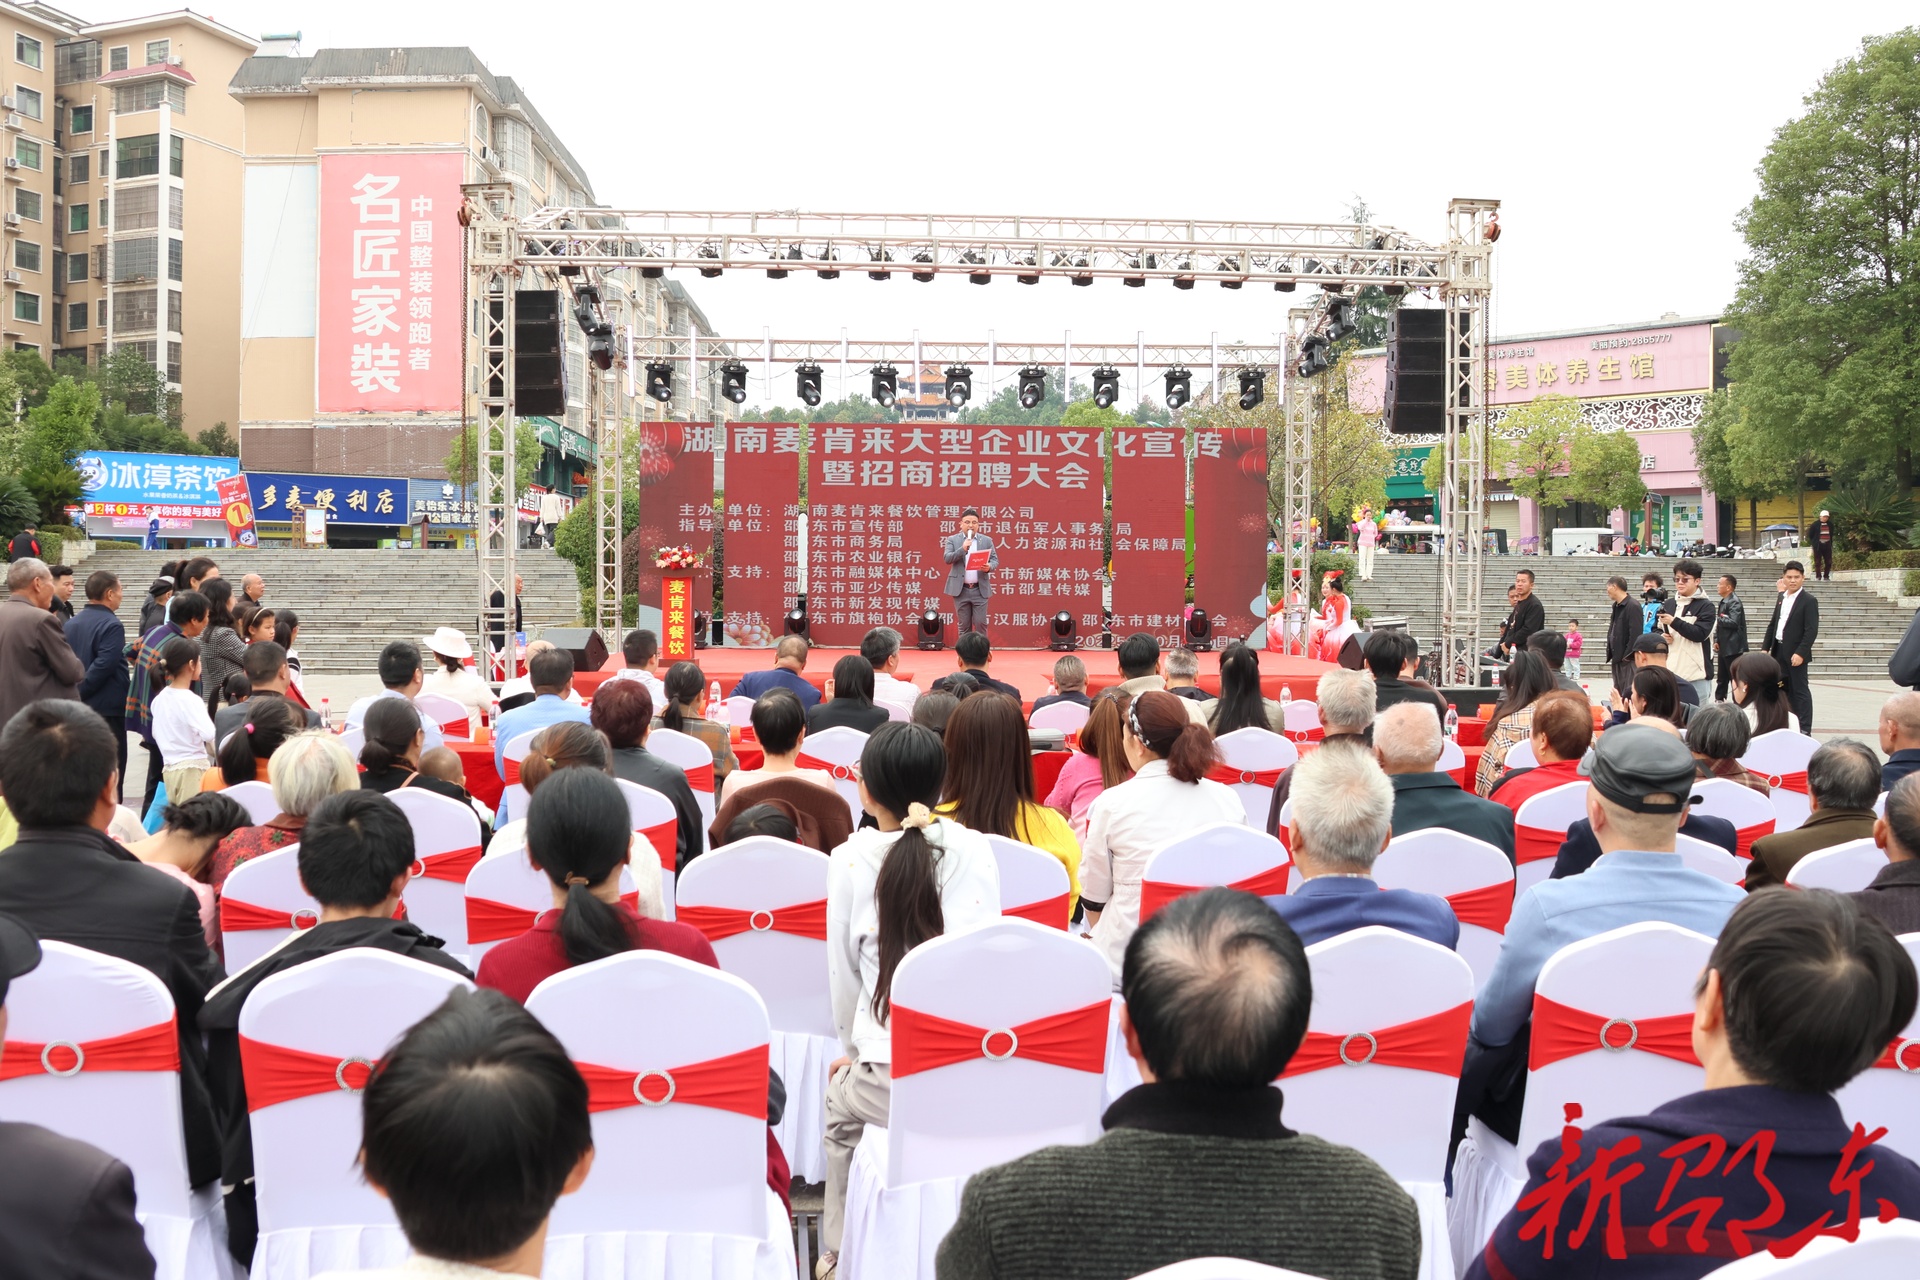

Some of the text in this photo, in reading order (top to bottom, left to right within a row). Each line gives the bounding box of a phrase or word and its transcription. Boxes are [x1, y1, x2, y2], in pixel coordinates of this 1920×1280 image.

[350, 171, 402, 395] 名匠家装
[408, 194, 433, 372] 中国整装领跑者
[683, 425, 1223, 459] 湖南麦肯来大型企业文化宣传
[109, 461, 231, 492] 冰淳茶饮
[821, 459, 1090, 489] 暨招商招聘大会
[783, 519, 904, 533] 邵东市宣传部
[939, 520, 1132, 536] 邵市退伍军人事务局
[783, 534, 904, 549] 邵东市商务局
[783, 550, 922, 564] 邵东市农业银行
[783, 565, 941, 580] 邵东市融媒体中心
[783, 581, 922, 595] 邵东市亚少传媒
[783, 596, 941, 610] 邵东市新发现传媒
[668, 579, 686, 656] 麦肯来餐饮
[783, 611, 921, 626] 东市旗袍协会
[1082, 613, 1228, 628] 邵东市建材会
